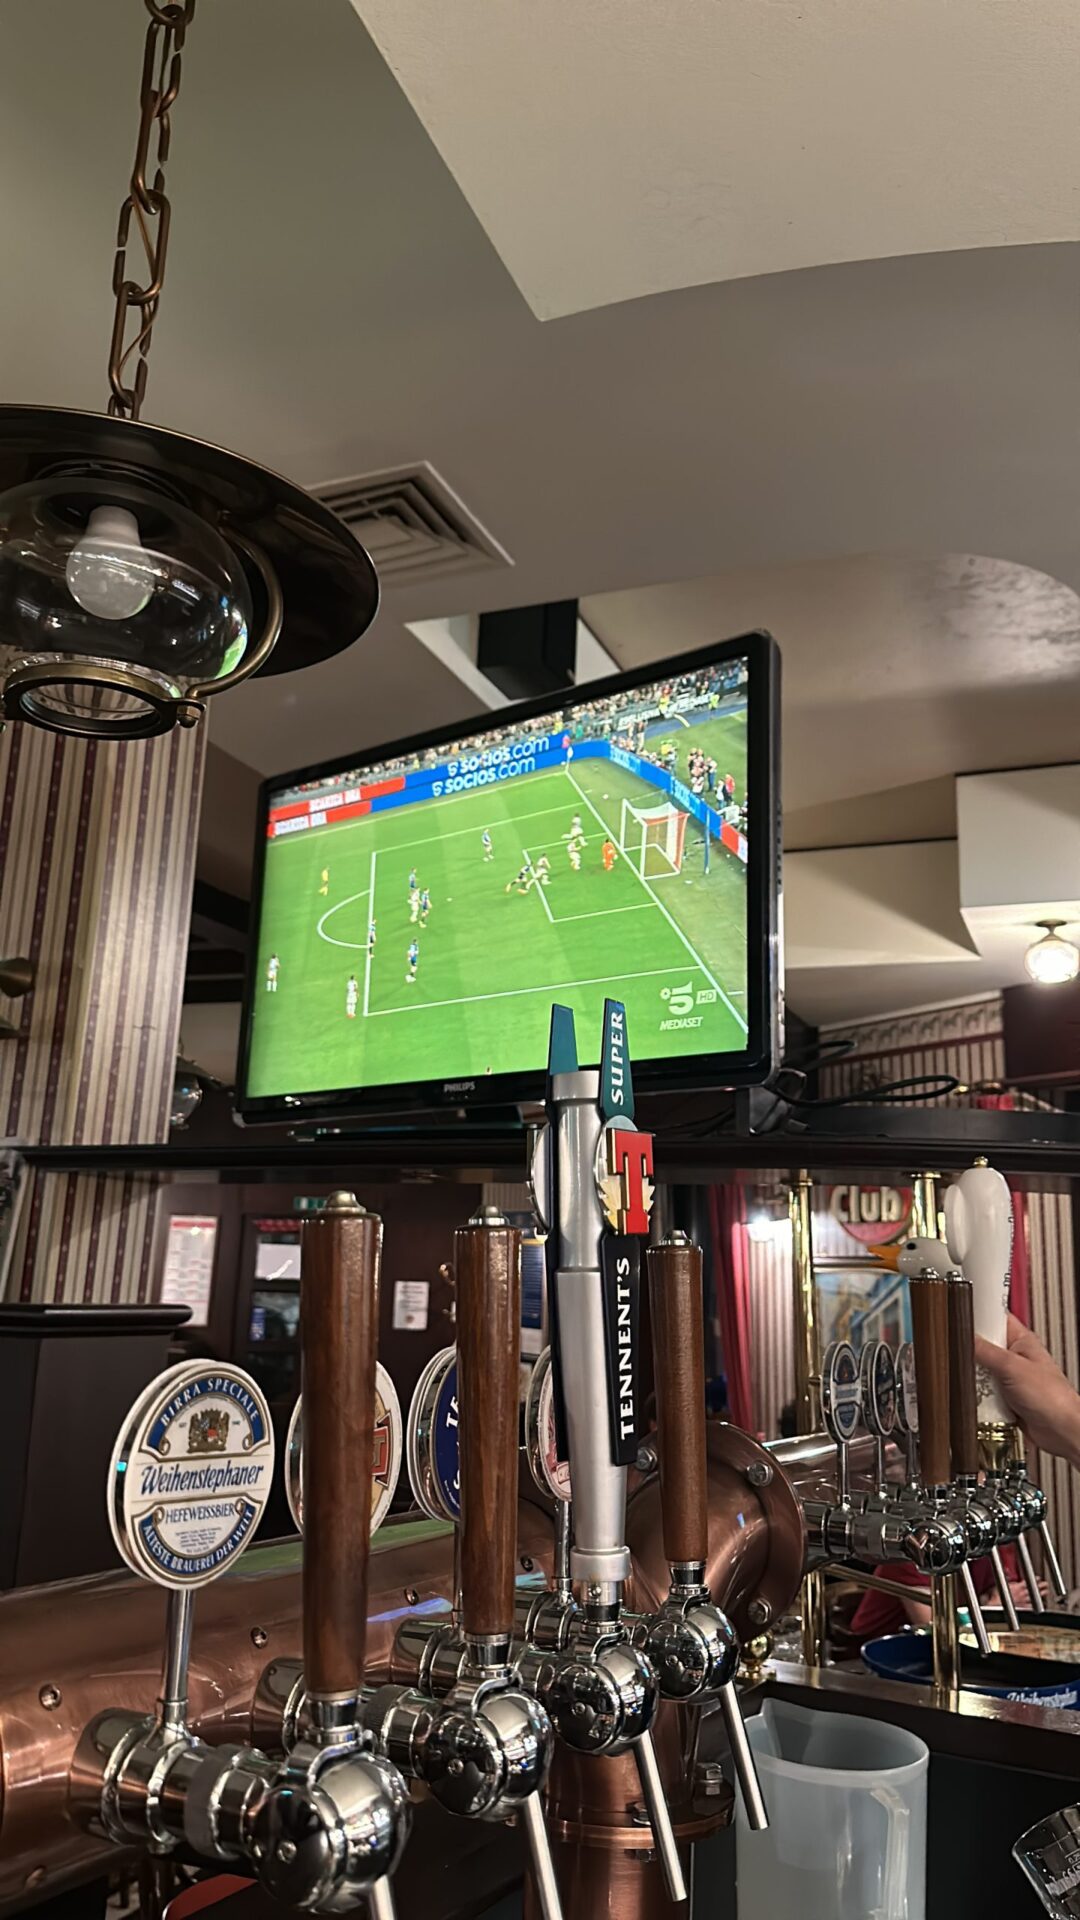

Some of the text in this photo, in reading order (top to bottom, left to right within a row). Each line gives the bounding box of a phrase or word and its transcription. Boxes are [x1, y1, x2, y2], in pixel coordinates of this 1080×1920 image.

[668, 981, 714, 1015] 5 HD
[659, 1016, 703, 1031] MEDIASET
[610, 1011, 625, 1107] SUPER
[444, 1081, 476, 1092] PHILIPS
[616, 1256, 635, 1442] TENNENT'S
[159, 1377, 260, 1427] BIRRA SPECIALE
[141, 1460, 264, 1495] Weihenstephaner
[165, 1502, 236, 1525] HEFEWEISSBIER
[171, 1557, 216, 1573] BRAUEREI
[215, 1540, 236, 1562] DER
[232, 1508, 254, 1543] WELT
